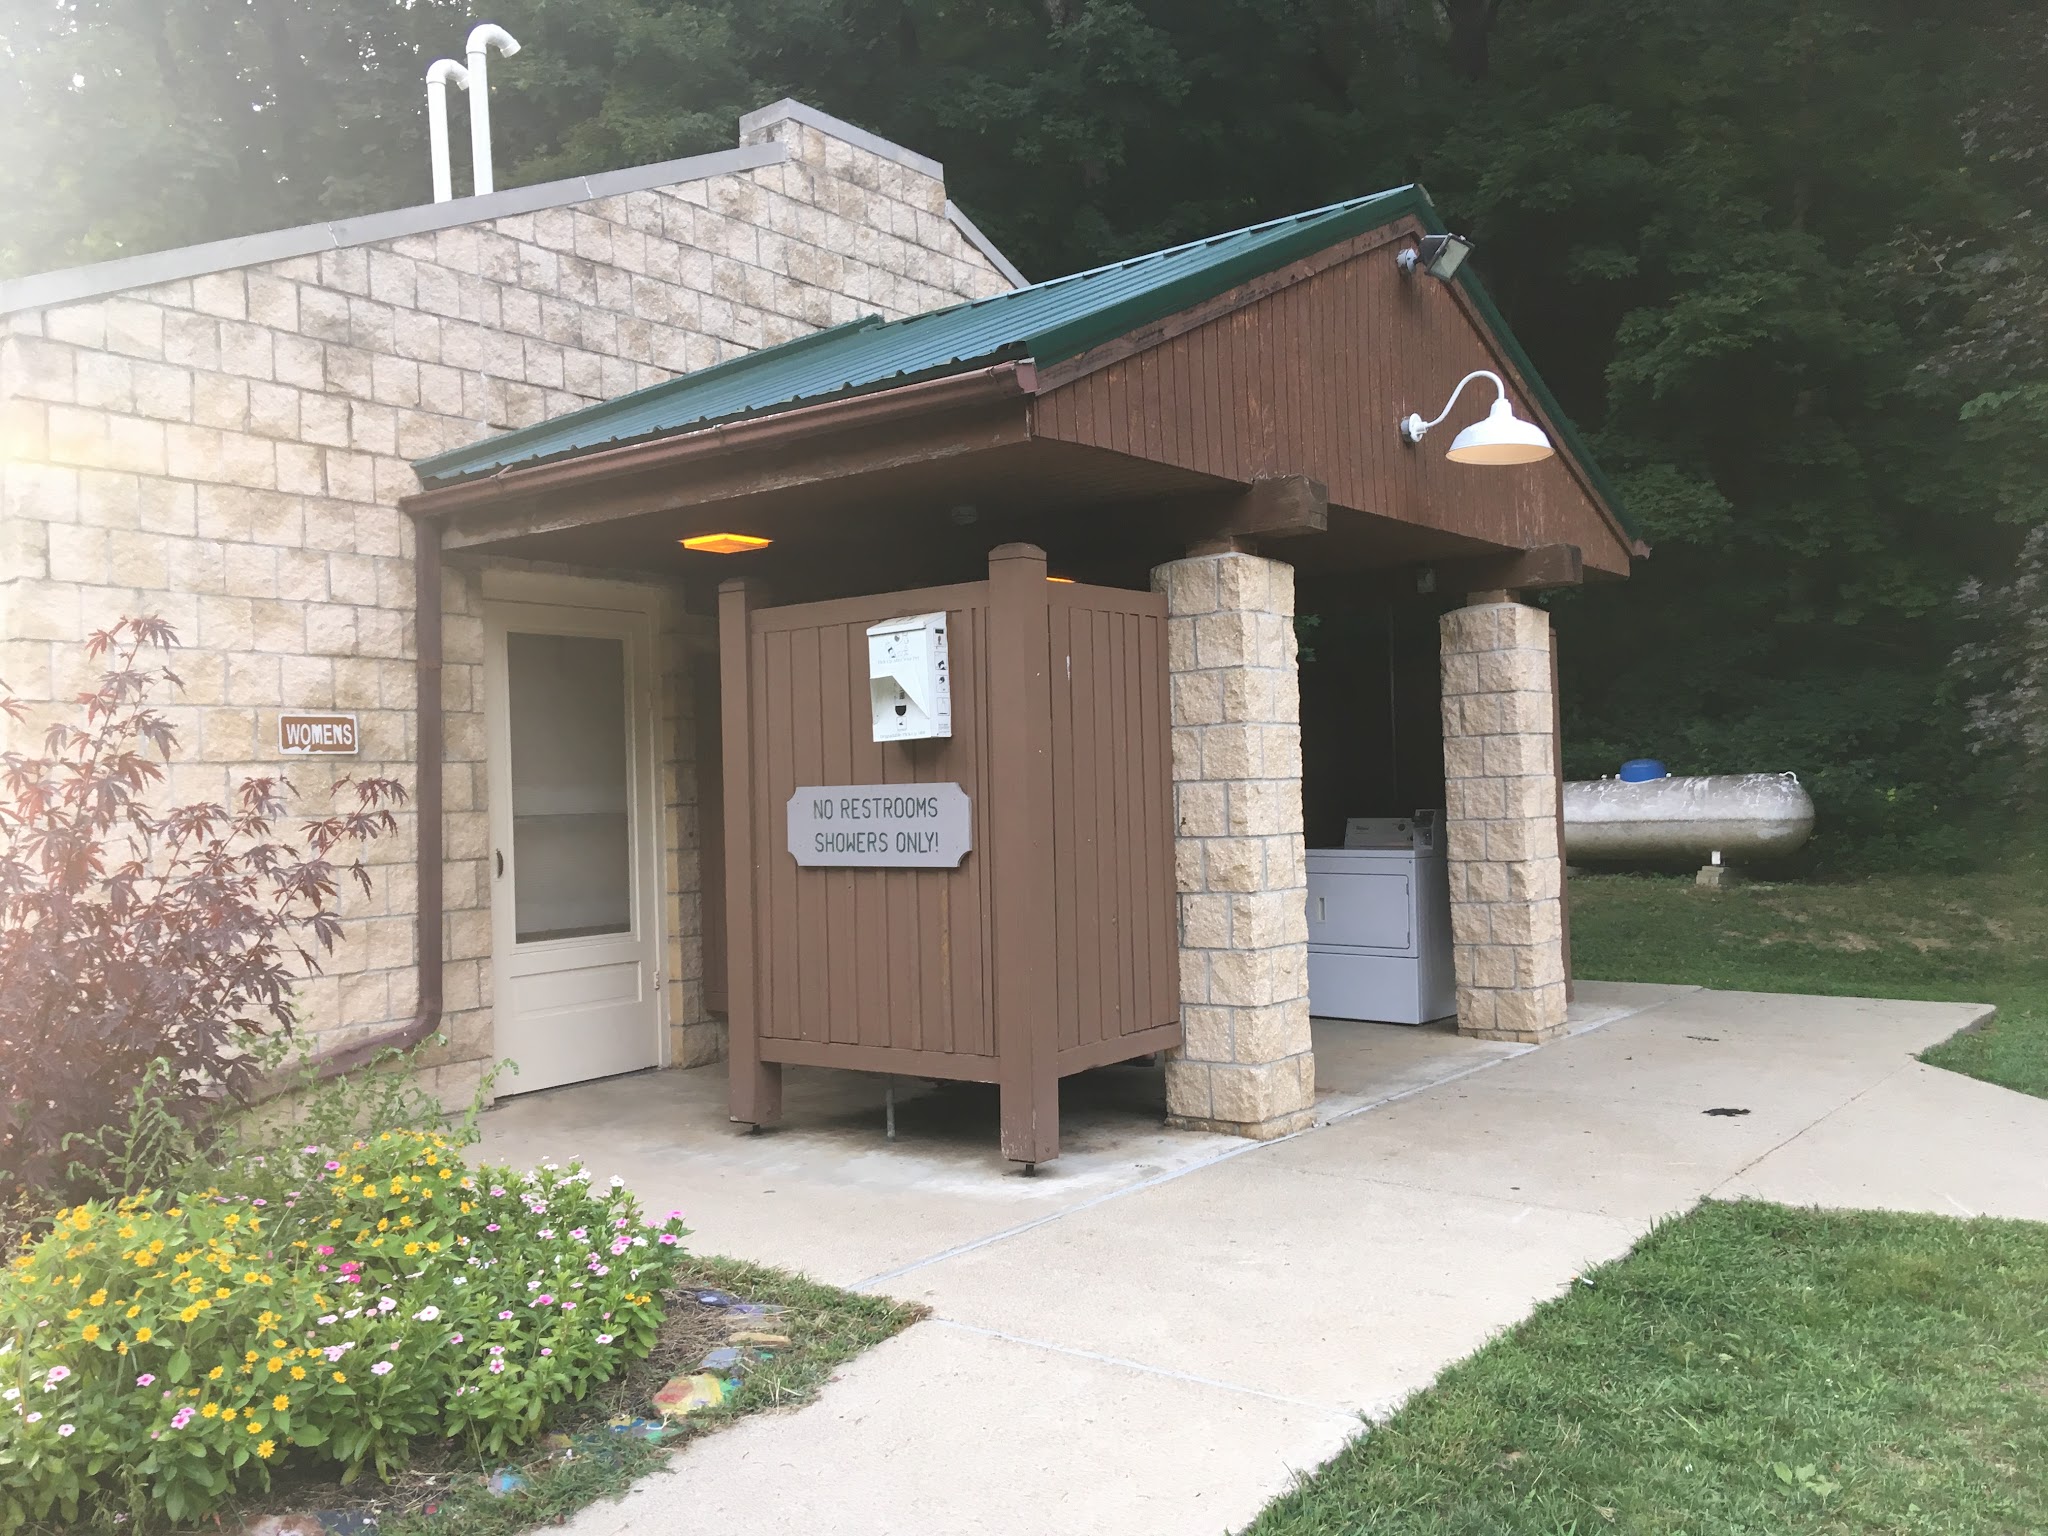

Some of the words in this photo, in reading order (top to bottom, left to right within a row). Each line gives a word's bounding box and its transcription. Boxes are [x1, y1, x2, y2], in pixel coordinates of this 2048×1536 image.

[285, 723, 353, 745] WOMENS
[813, 799, 833, 819] NO
[840, 797, 938, 819] RESTROOMS
[814, 832, 888, 853] SHOWERS
[896, 831, 939, 853] ONLY!
